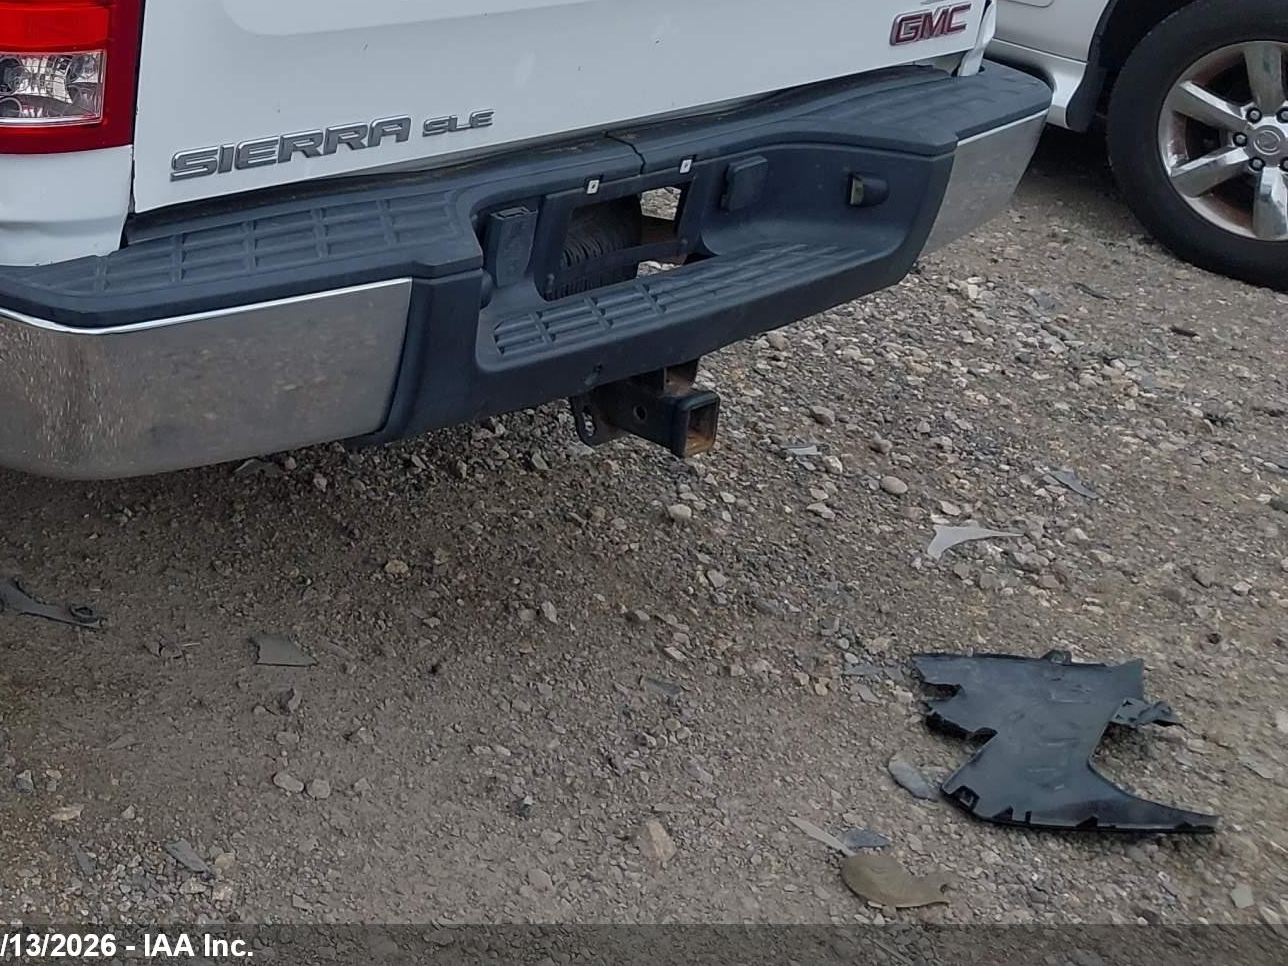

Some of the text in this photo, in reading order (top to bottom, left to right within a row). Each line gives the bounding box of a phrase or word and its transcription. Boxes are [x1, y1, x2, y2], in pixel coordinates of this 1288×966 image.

[889, 1, 972, 46] GMC
[170, 108, 494, 182] SIERRA SLE
